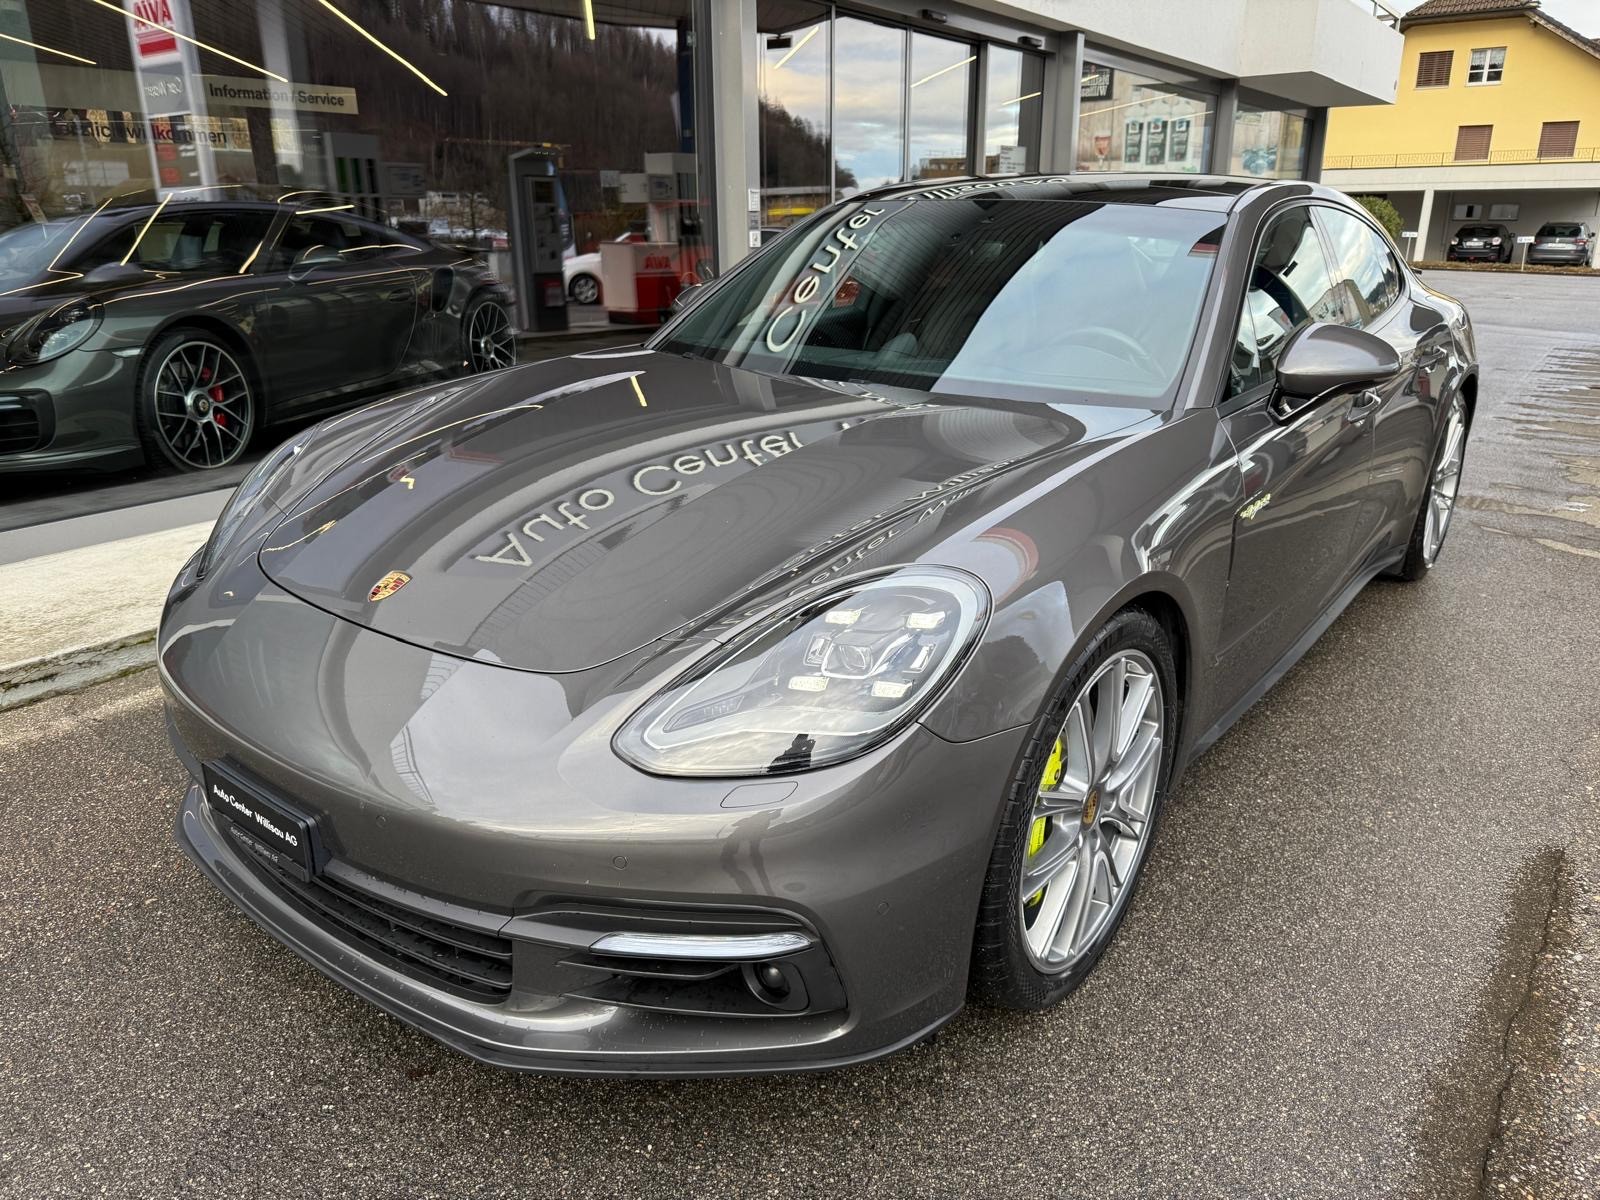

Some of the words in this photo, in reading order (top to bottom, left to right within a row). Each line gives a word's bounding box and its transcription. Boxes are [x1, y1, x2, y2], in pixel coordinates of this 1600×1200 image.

[209, 83, 288, 101] Information
[298, 90, 345, 106] Service
[213, 784, 229, 802] Auto
[229, 795, 253, 818] Center
[254, 811, 284, 839] Willisau
[285, 831, 298, 847] AG
